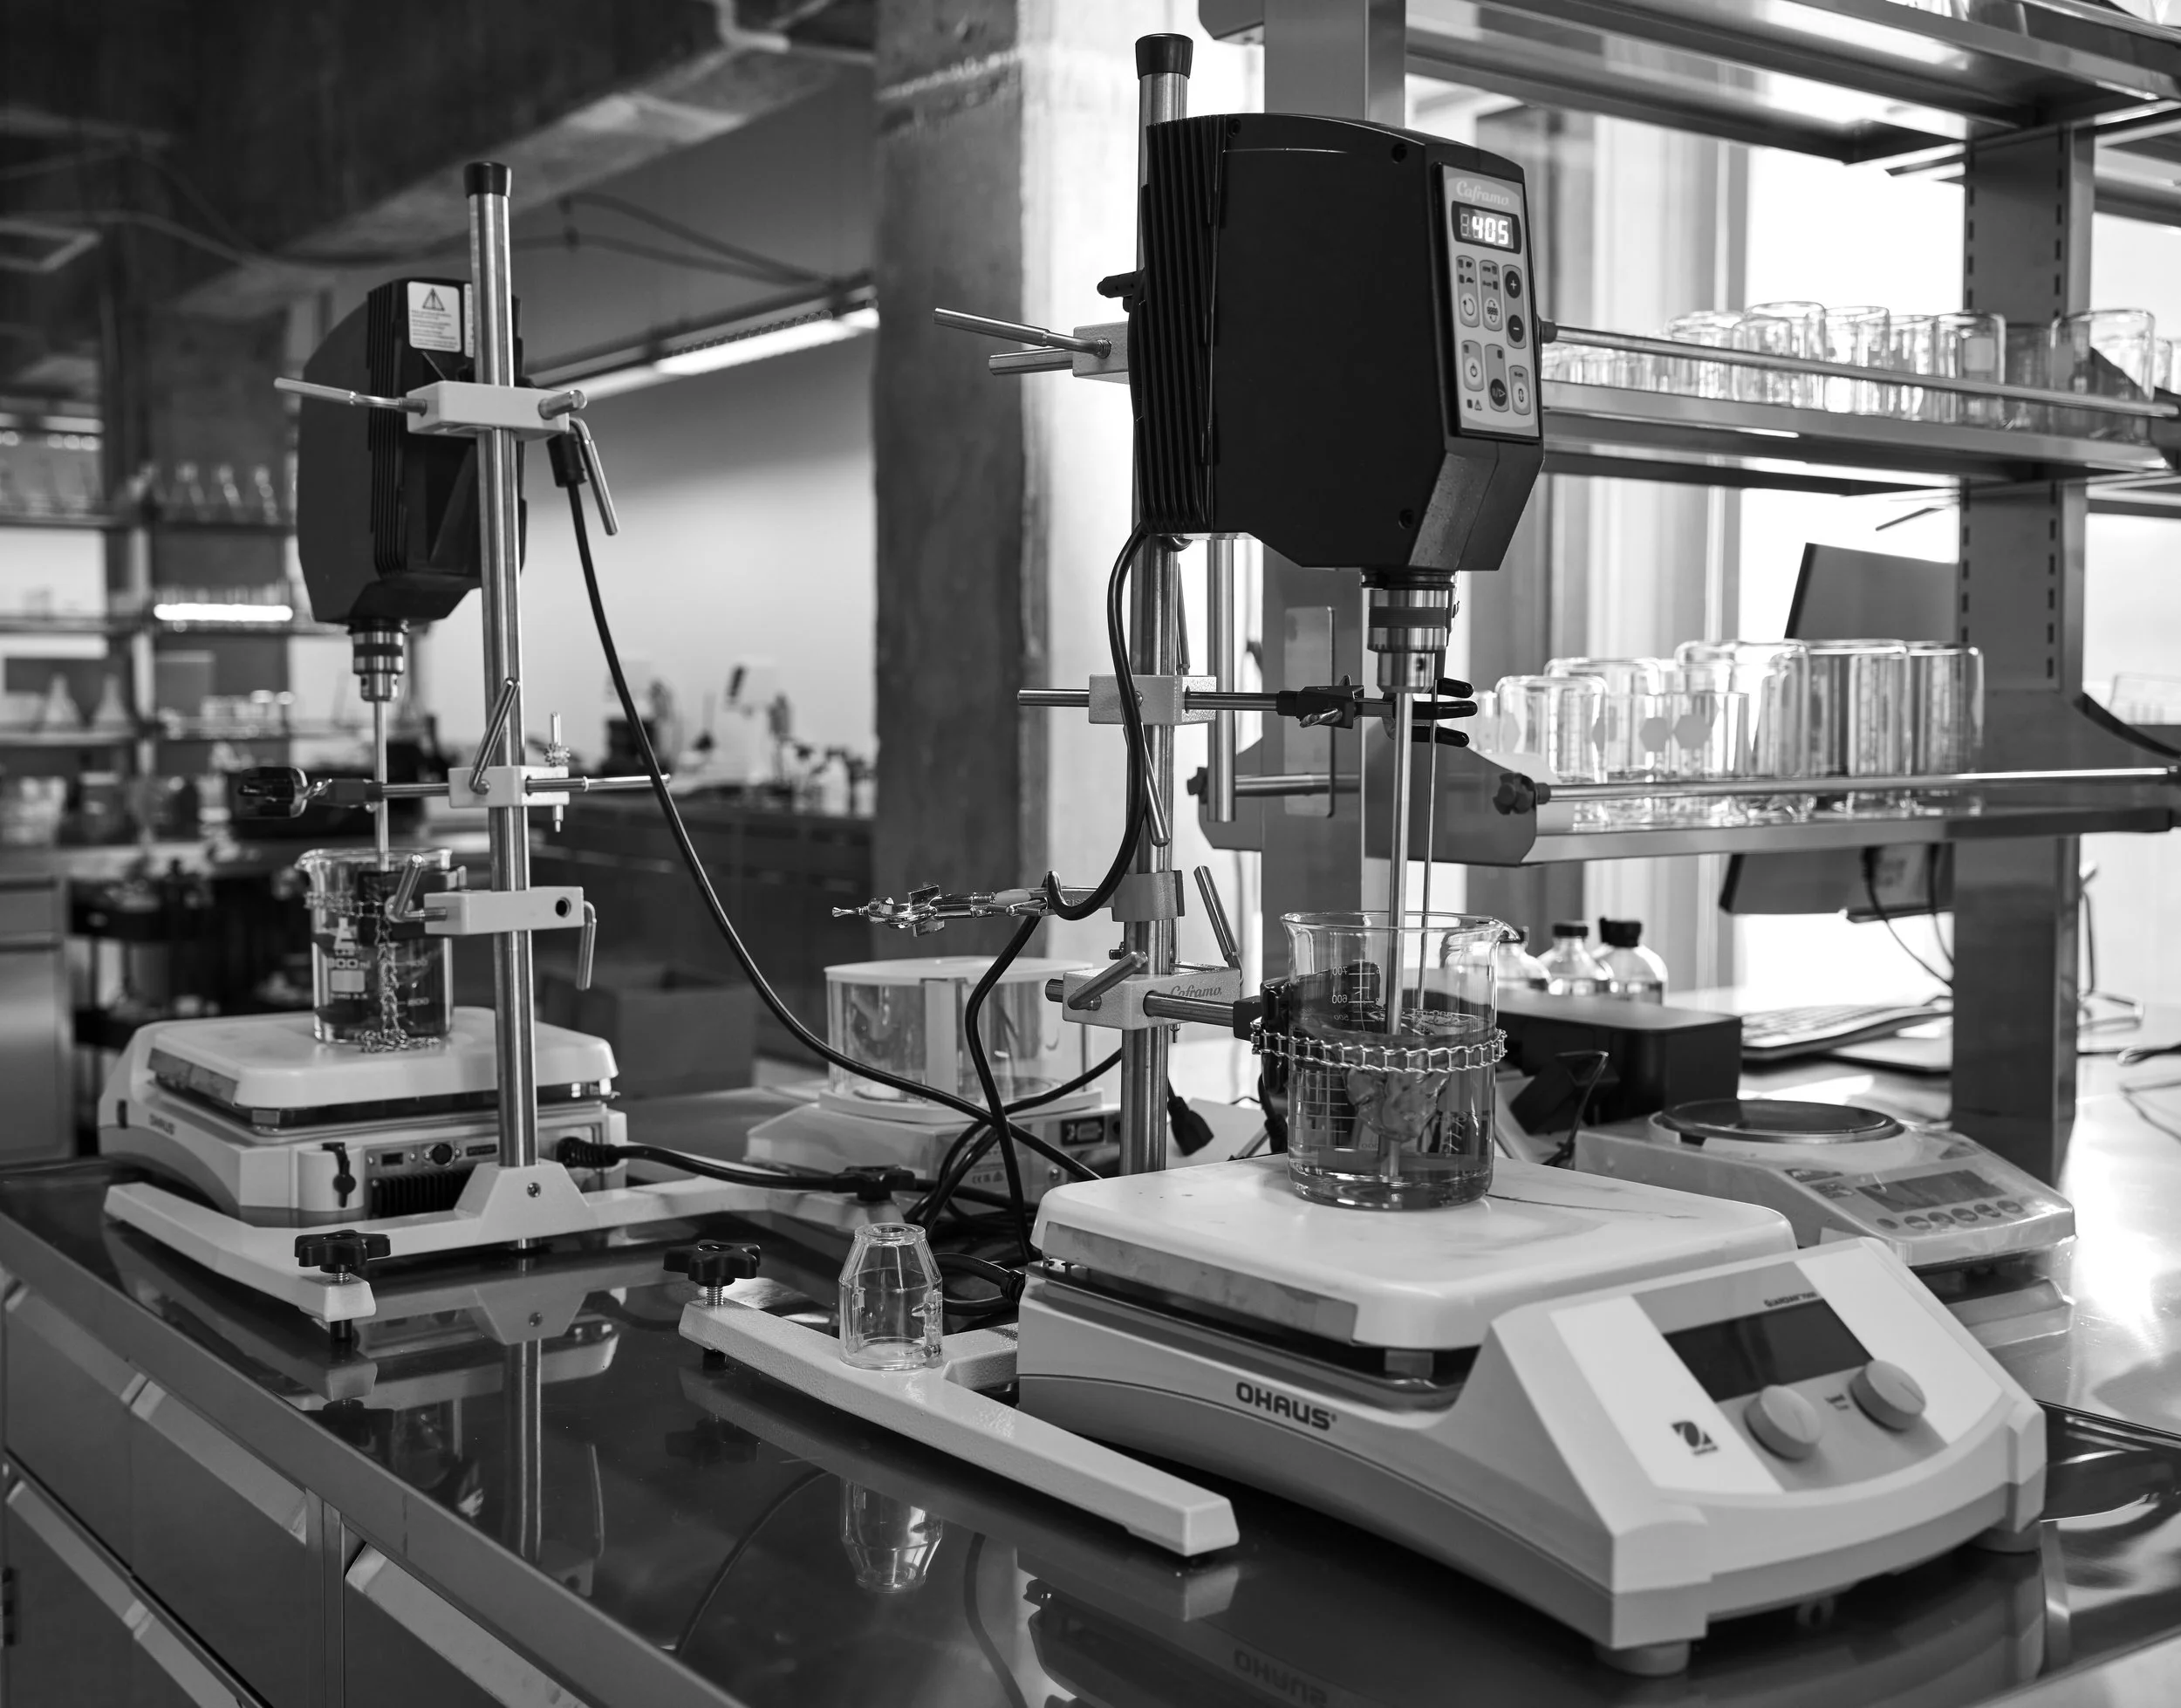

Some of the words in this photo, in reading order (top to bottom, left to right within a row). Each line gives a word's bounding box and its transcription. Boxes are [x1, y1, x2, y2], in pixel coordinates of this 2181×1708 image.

[1456, 181, 1510, 206] Caframo
[1472, 215, 1509, 245] 405
[1170, 984, 1220, 998] Caframo
[1235, 1381, 1330, 1431] OHAUS
